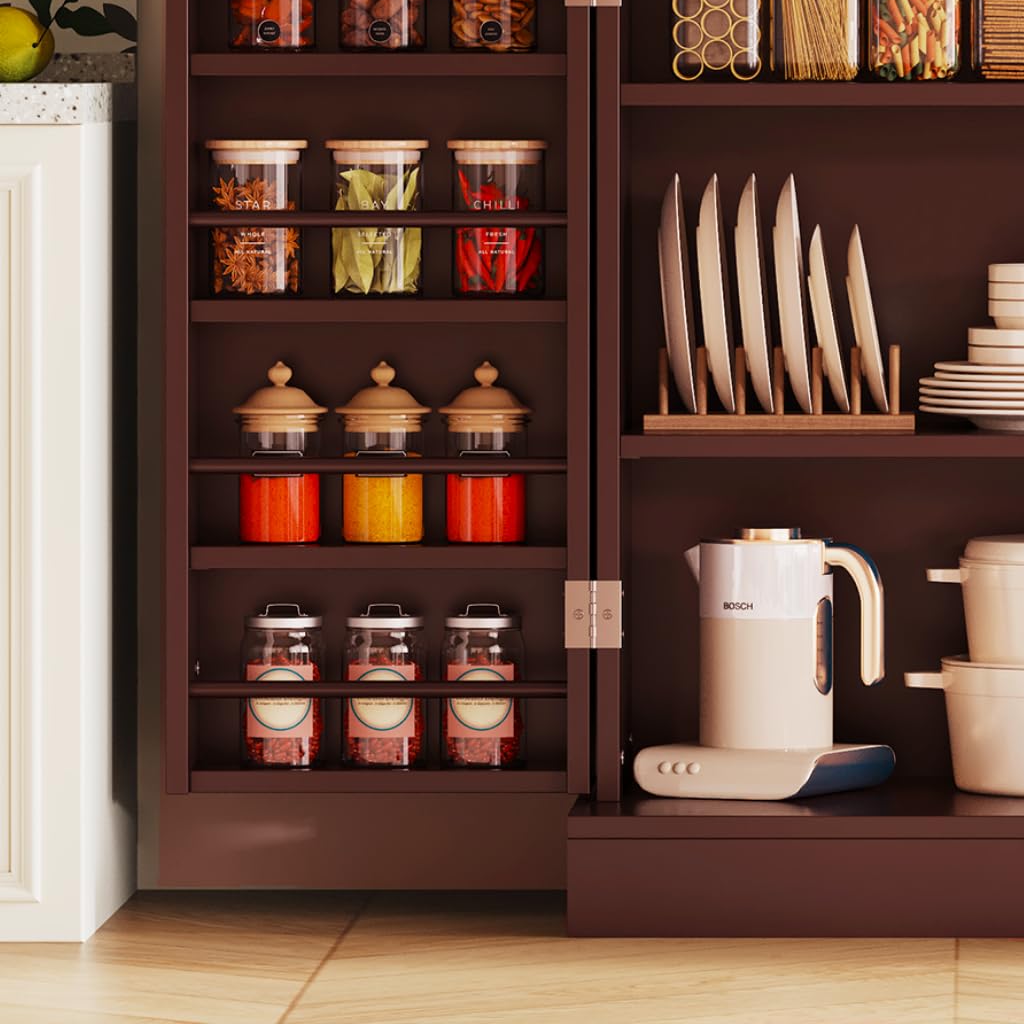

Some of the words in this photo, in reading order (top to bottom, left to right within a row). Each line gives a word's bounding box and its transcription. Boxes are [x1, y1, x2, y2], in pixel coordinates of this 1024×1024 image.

[235, 200, 271, 210] STAR
[361, 200, 387, 210] BAY
[473, 200, 520, 210] CHILLI
[723, 601, 754, 611] BOSCH
